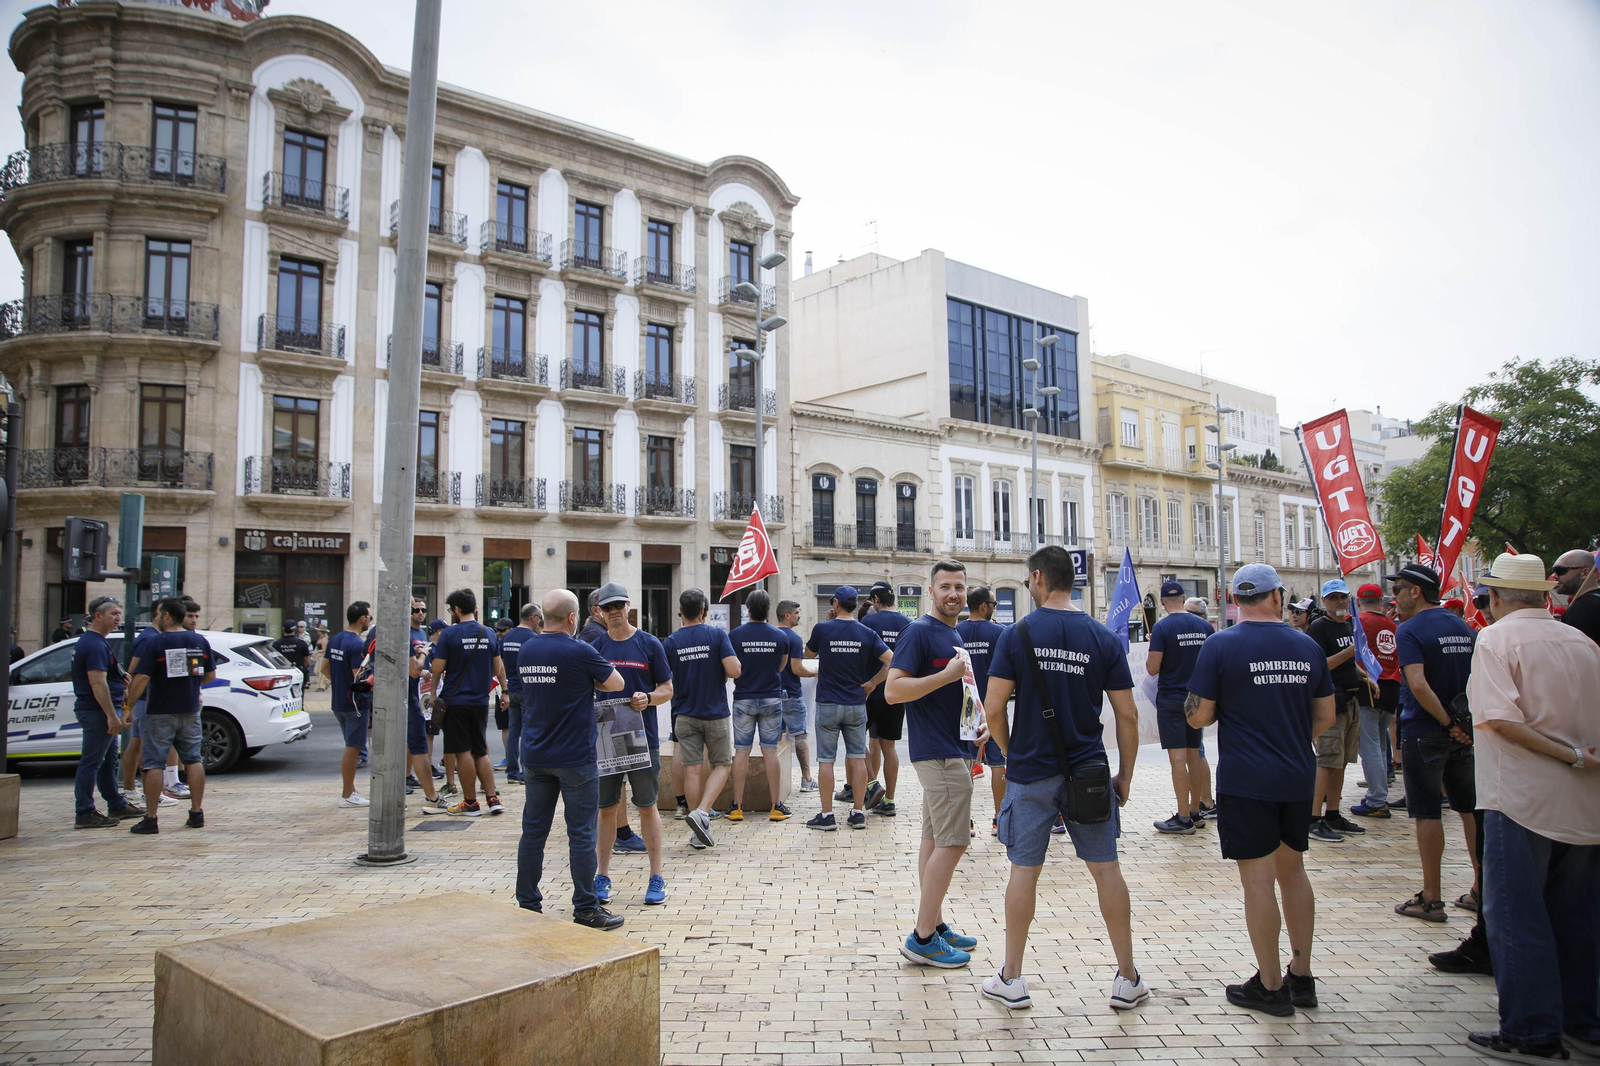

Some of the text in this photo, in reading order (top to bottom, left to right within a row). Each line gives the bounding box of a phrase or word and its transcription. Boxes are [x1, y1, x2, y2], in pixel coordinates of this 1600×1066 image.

[1315, 424, 1353, 513] UGT
[1443, 428, 1488, 547] UGT
[1339, 524, 1368, 545] UGT
[272, 532, 343, 551] cajamar
[1176, 632, 1207, 640] BOMBEROS
[1378, 634, 1394, 644] UGT
[677, 645, 710, 655] BOMBEROS
[1033, 647, 1090, 664] BOMBEROS
[679, 652, 709, 662] QUEMADOS
[519, 666, 558, 674] BOMBEROS
[1249, 660, 1311, 673] BOMBEROS
[1253, 674, 1308, 685] QUEMADOS
[8, 713, 55, 724] ALMERÍA
